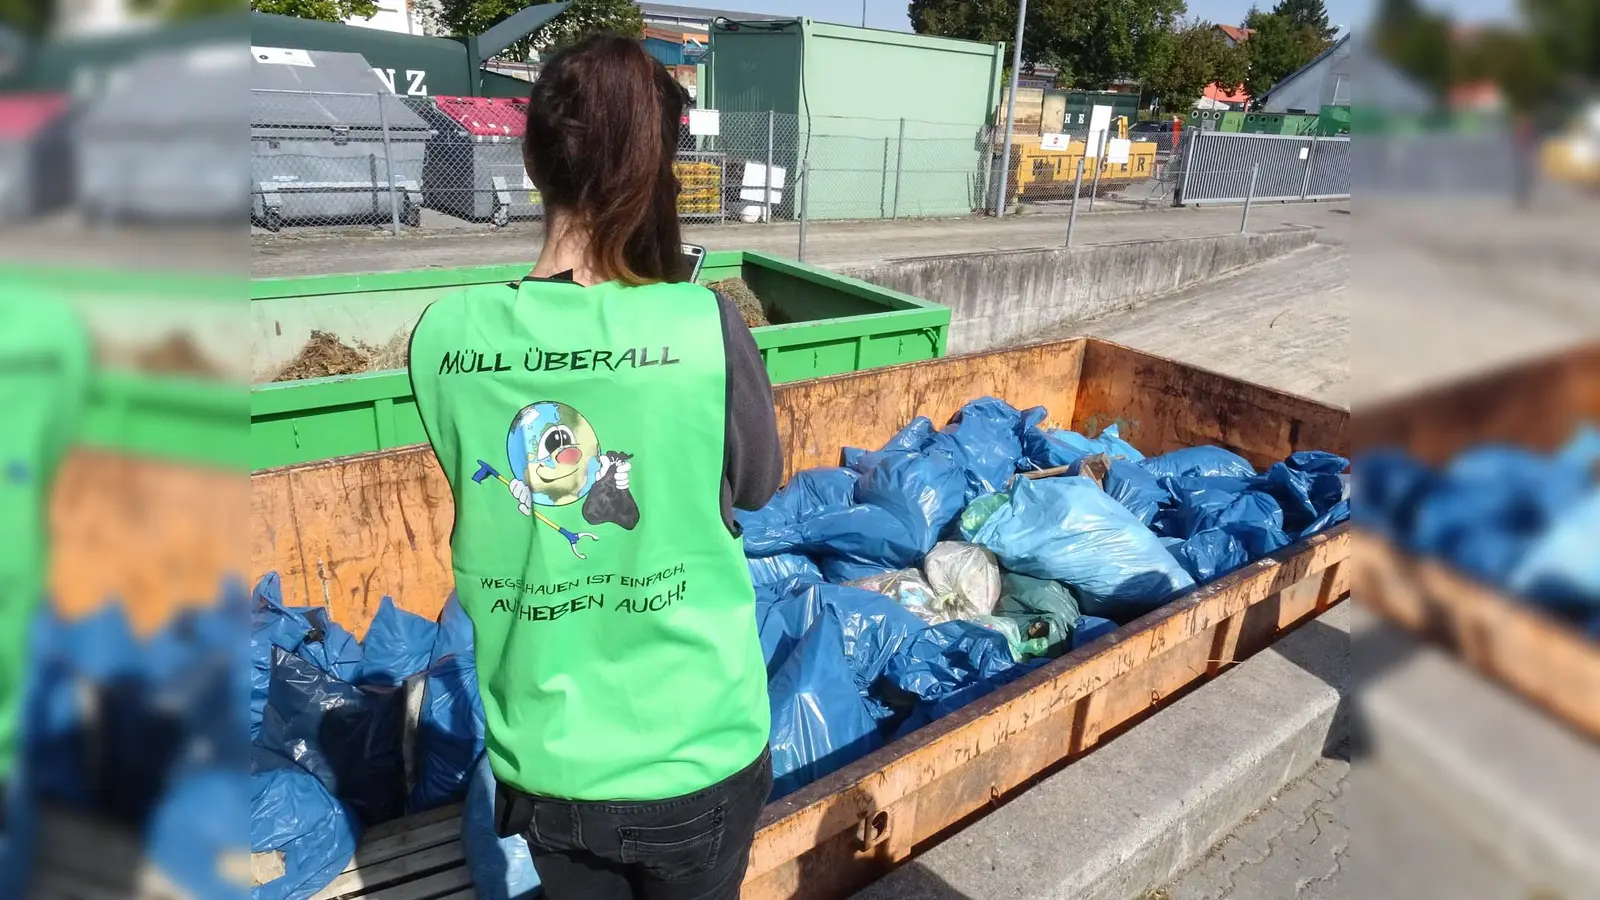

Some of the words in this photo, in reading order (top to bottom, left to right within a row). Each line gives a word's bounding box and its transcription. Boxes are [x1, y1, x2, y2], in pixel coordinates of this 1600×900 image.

[439, 349, 511, 374] MÜLL
[523, 347, 680, 372] ÜBERALL
[480, 577, 580, 595] WEGSHAUEN
[586, 573, 616, 585] IST
[490, 593, 604, 621] AUHEBEN
[615, 581, 686, 614] AUCH!
